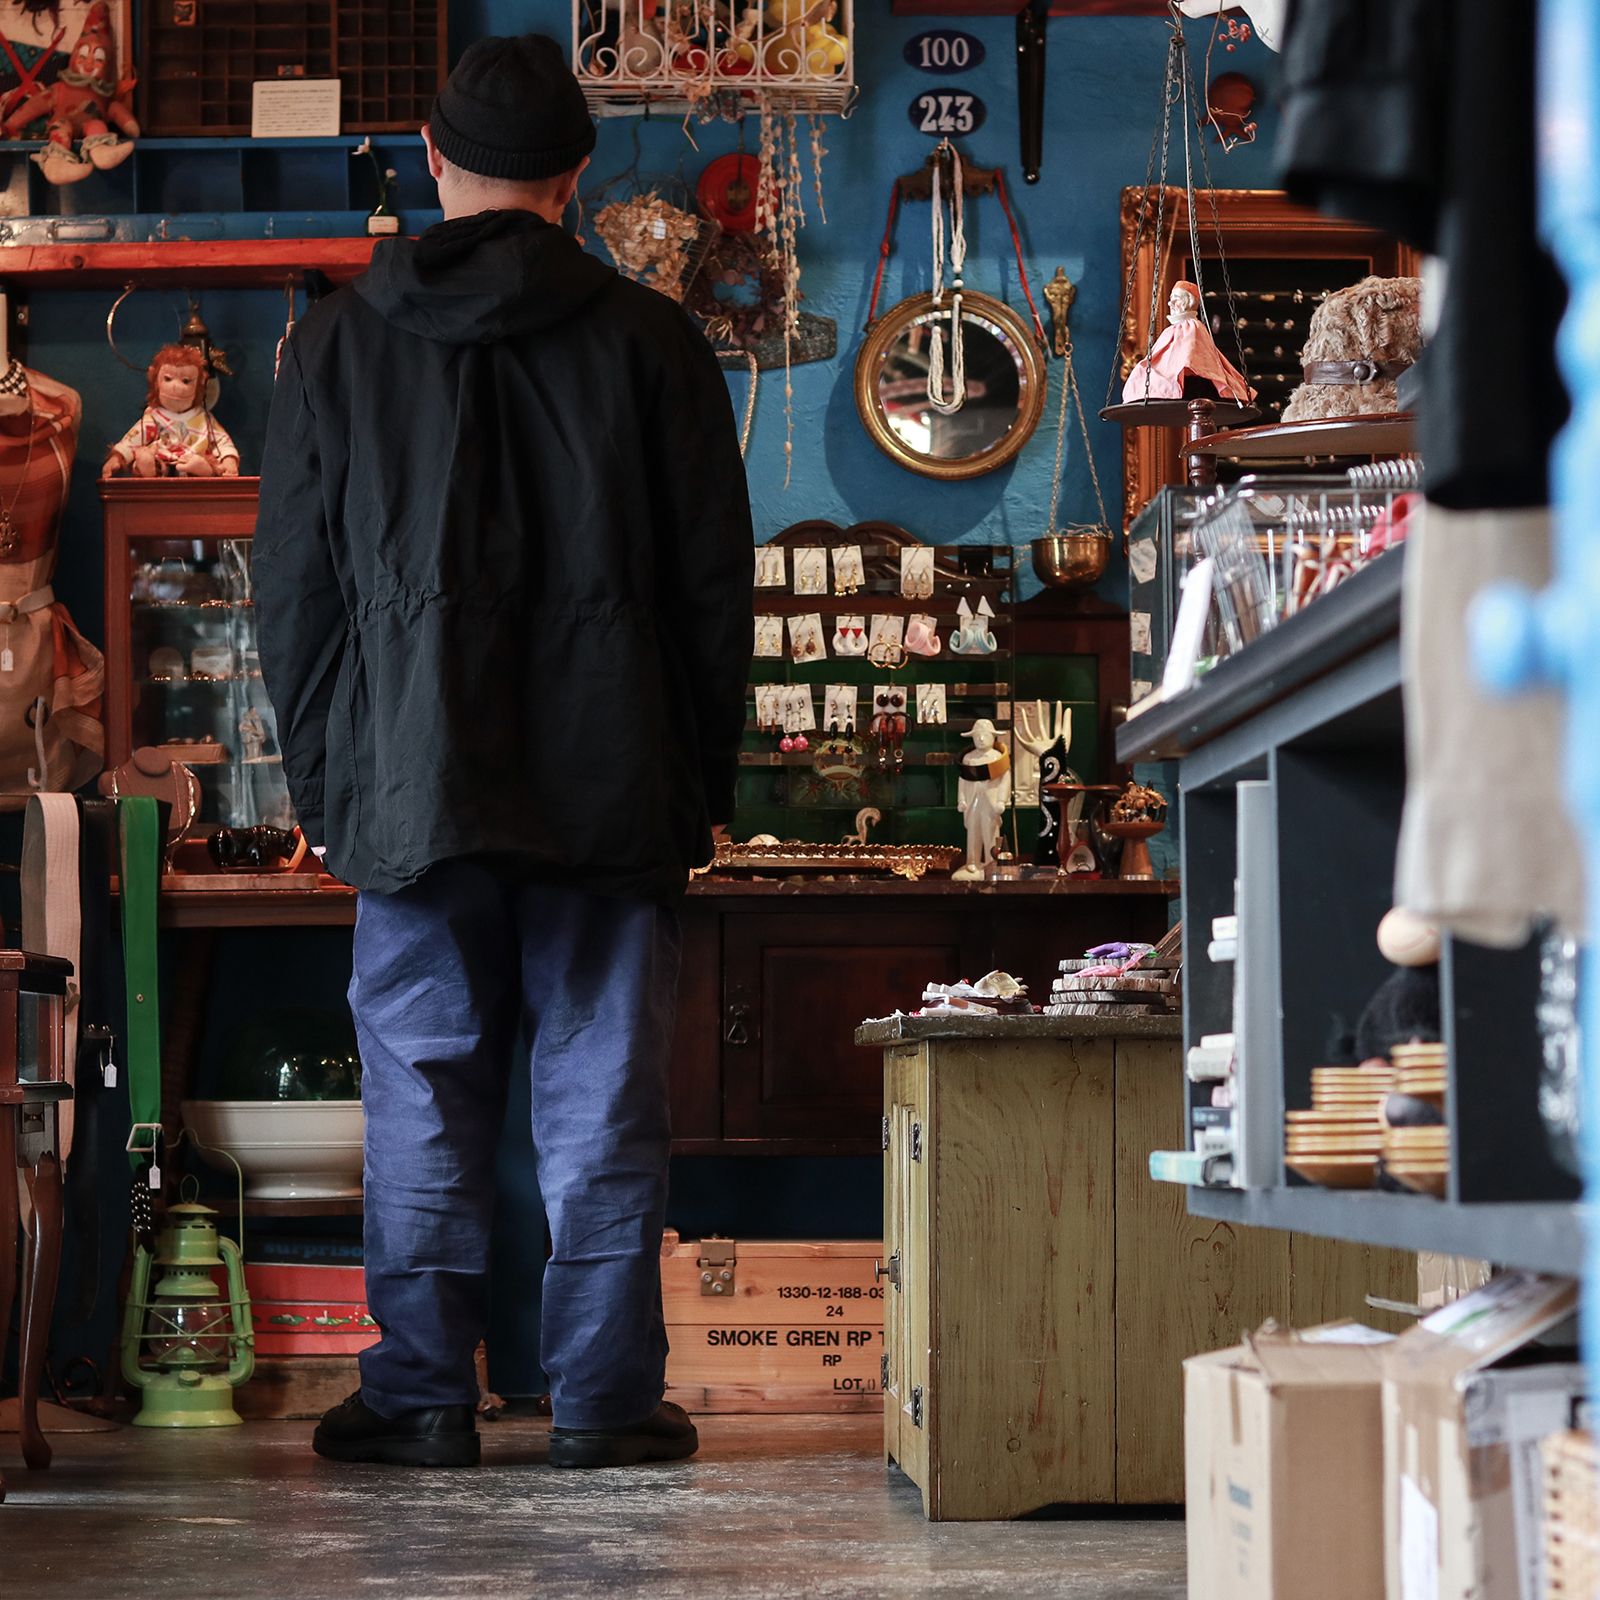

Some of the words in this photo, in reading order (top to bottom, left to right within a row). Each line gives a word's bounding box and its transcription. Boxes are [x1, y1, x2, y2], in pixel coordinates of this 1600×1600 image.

[919, 37, 970, 67] 100
[918, 95, 974, 132] 243
[826, 1305, 844, 1317] 24
[707, 1330, 778, 1346] SMOKE
[786, 1330, 840, 1346] GREN
[847, 1330, 872, 1346] RP
[822, 1354, 842, 1366] RP
